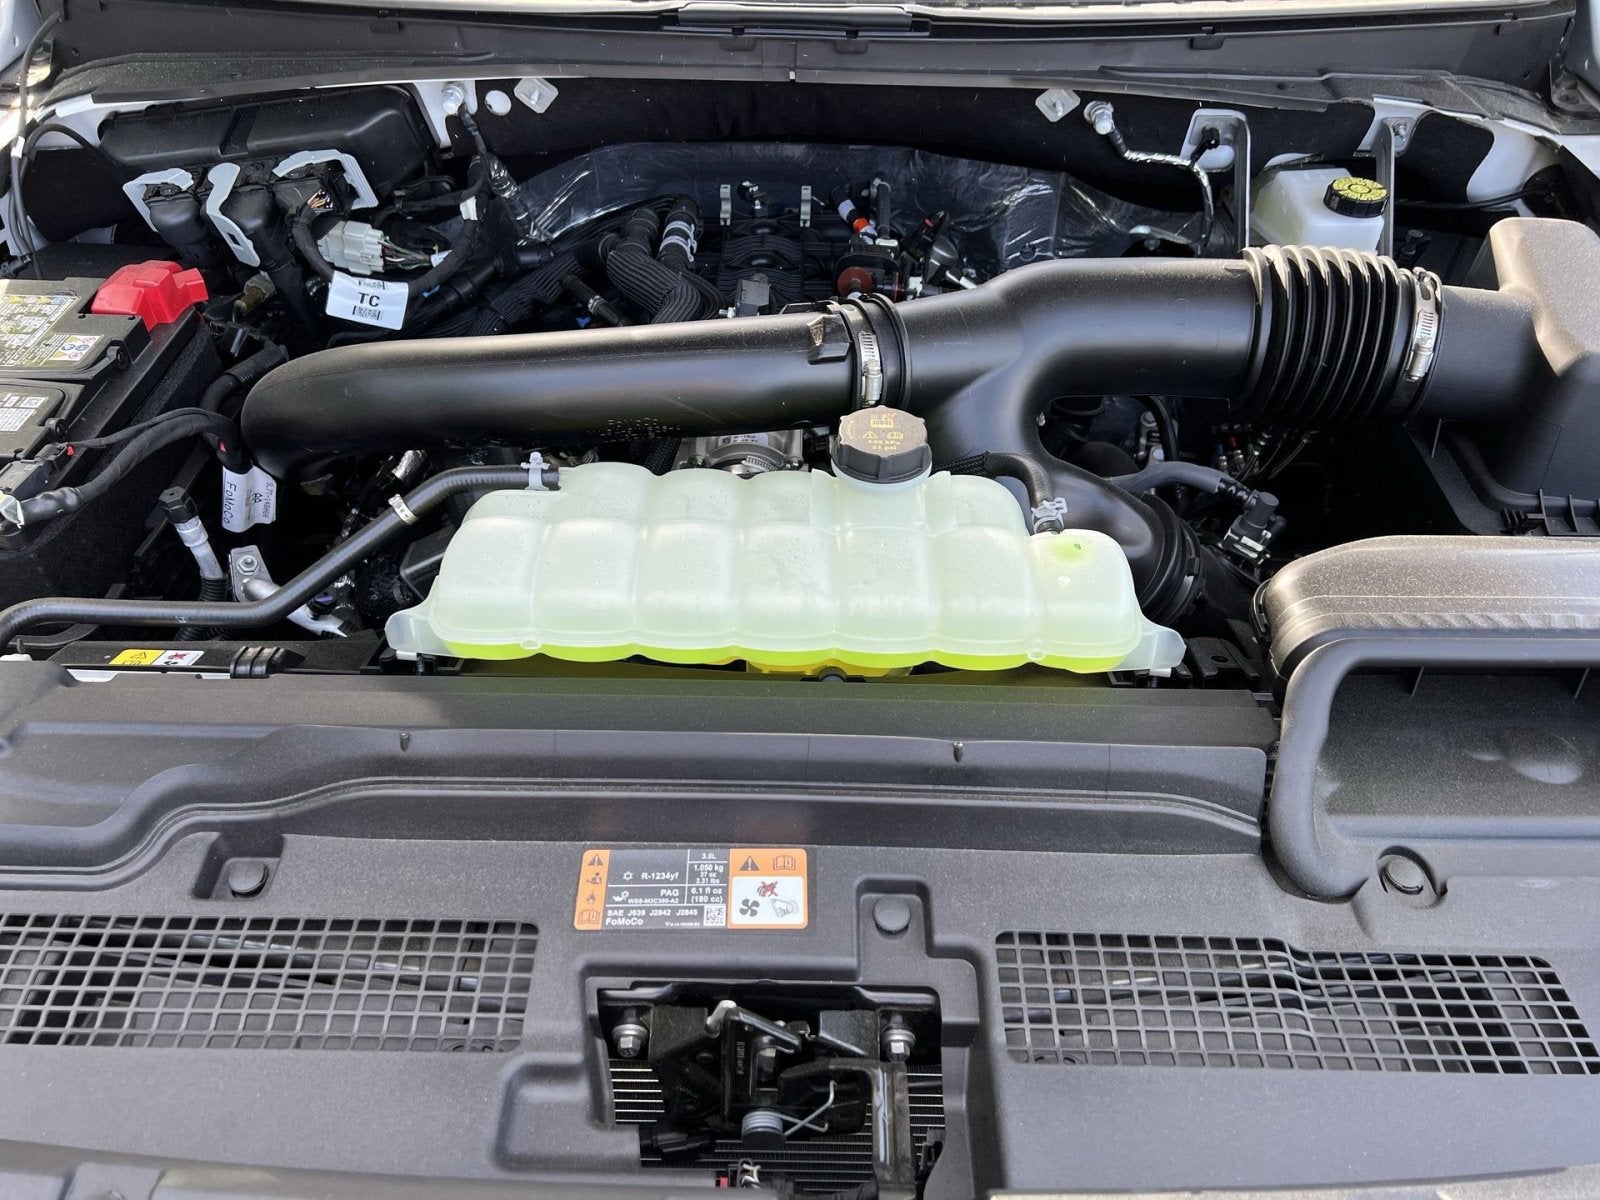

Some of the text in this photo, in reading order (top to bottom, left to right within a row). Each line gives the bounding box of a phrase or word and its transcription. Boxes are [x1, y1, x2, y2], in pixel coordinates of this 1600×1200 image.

[358, 291, 380, 308] TC
[223, 482, 236, 524] FoMoCo
[715, 864, 724, 873] kg
[641, 872, 679, 882] R-1234yf
[691, 896, 723, 904] (180 cc)
[605, 917, 644, 926] FoMoCo
